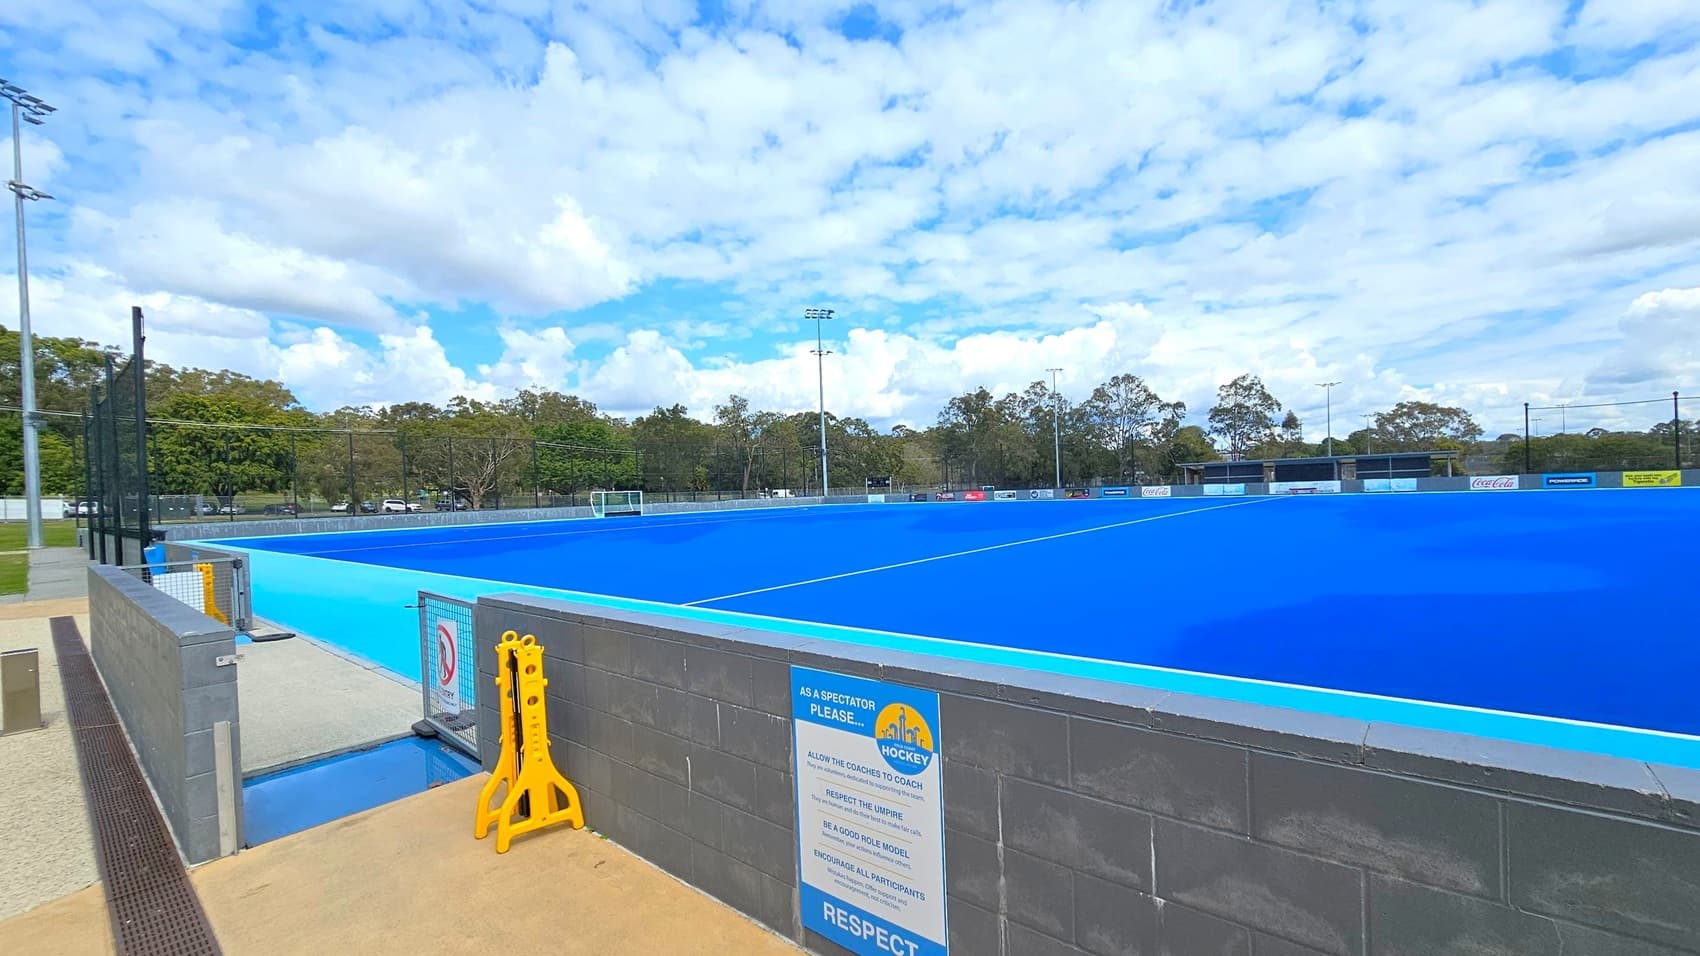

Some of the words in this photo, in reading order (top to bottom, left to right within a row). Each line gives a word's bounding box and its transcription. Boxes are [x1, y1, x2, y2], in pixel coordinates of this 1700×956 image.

[1472, 477, 1516, 488] Coca-Cola
[800, 686, 811, 697] AS
[813, 689, 819, 699] A
[821, 690, 875, 711] SPECTATOR
[811, 703, 864, 727] PLEASE...
[808, 751, 830, 764] ALLOW
[832, 758, 844, 768] THE
[847, 762, 880, 778] COACHES
[883, 773, 892, 782] TO
[895, 776, 922, 791] COACH
[882, 746, 929, 767] HOCKEY
[826, 790, 856, 806] RESPECT
[859, 800, 872, 811] THE
[875, 805, 903, 821] UMPIRE
[824, 822, 832, 830] BE
[840, 827, 859, 840] GOOD
[861, 835, 880, 848] ROLE
[883, 843, 910, 859] MODEL
[814, 850, 855, 873] ENCOURAGE
[856, 867, 869, 879] ALL
[871, 873, 925, 902] PARTICIPANTS
[824, 901, 918, 956] RESPECT
